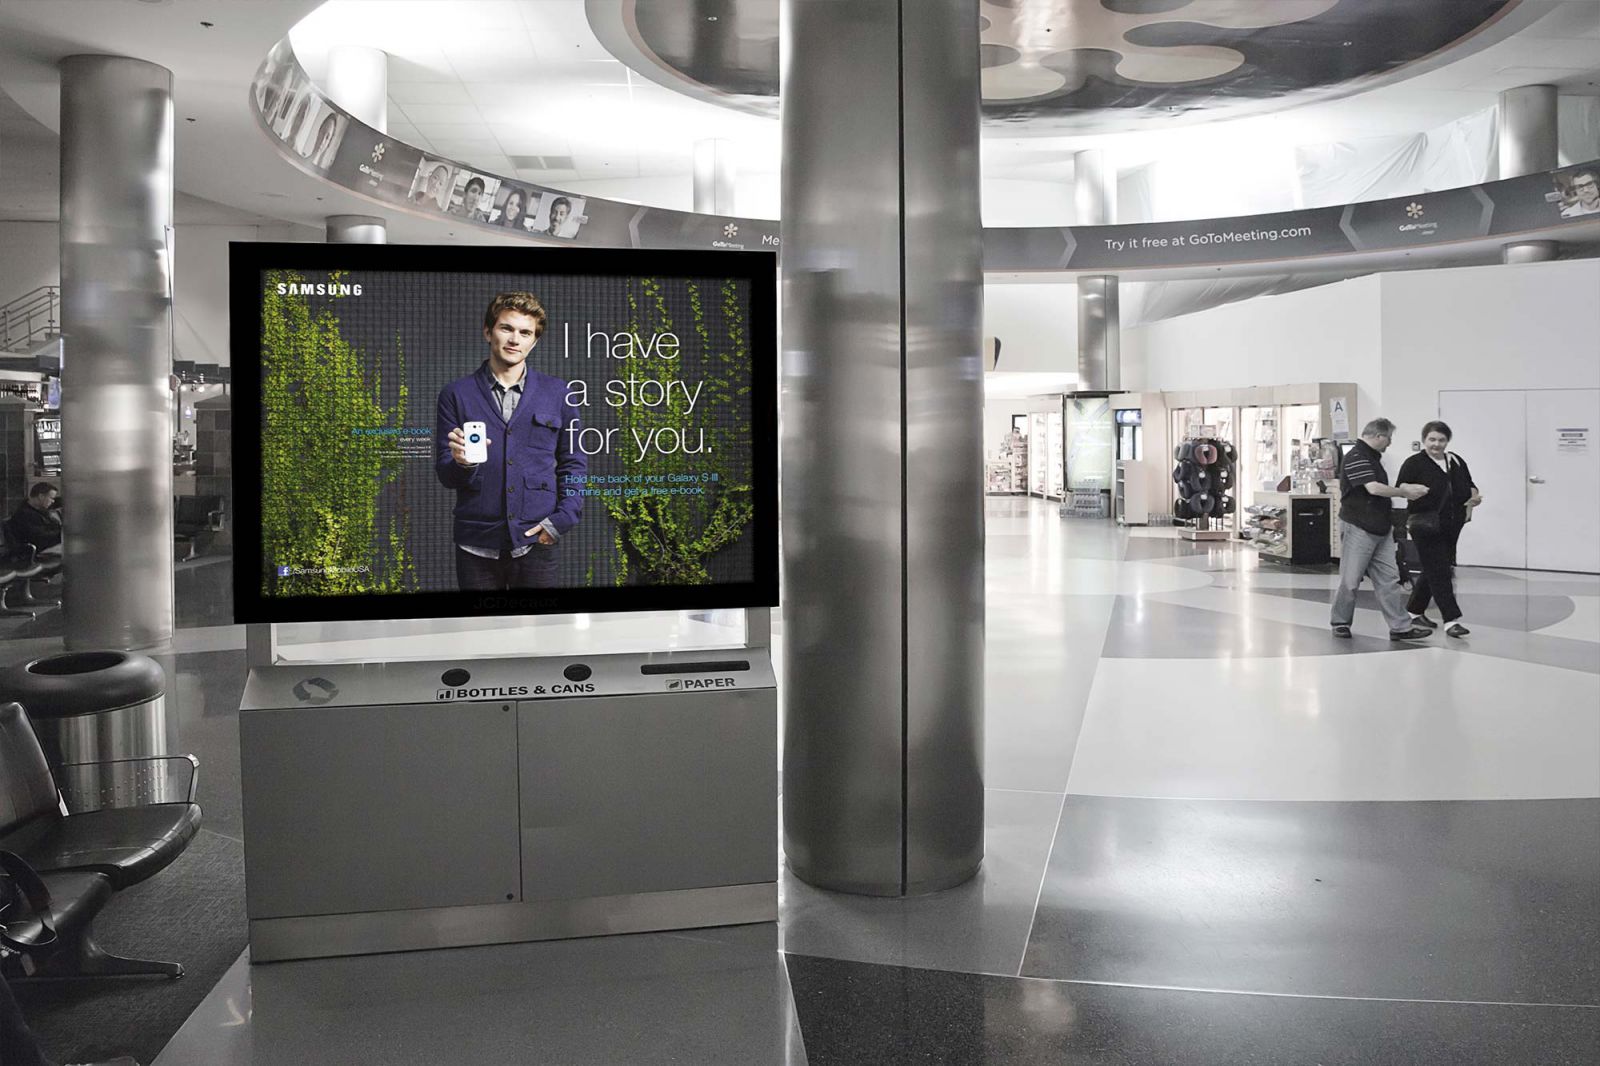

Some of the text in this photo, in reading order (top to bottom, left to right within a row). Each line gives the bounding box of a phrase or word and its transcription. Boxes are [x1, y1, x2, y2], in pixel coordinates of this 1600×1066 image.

[1105, 226, 1311, 251] Try it free at GoToMeeting.com
[277, 282, 363, 297] SAMSUNG
[564, 322, 680, 360] I have
[565, 373, 703, 415] a story
[1334, 401, 1344, 412] A
[565, 418, 713, 463] for you.
[565, 474, 588, 484] Hold
[590, 474, 606, 483] the
[607, 474, 631, 483] back
[633, 473, 643, 483] of
[645, 474, 665, 484] your
[667, 473, 699, 483] Galaxy
[701, 472, 709, 482] S
[565, 488, 576, 497] to
[578, 487, 600, 496] mine
[603, 486, 622, 496] and
[623, 487, 640, 497] get
[650, 486, 669, 495] free
[457, 683, 595, 698] BOTTLES & CANS
[684, 677, 736, 689] PAPER
